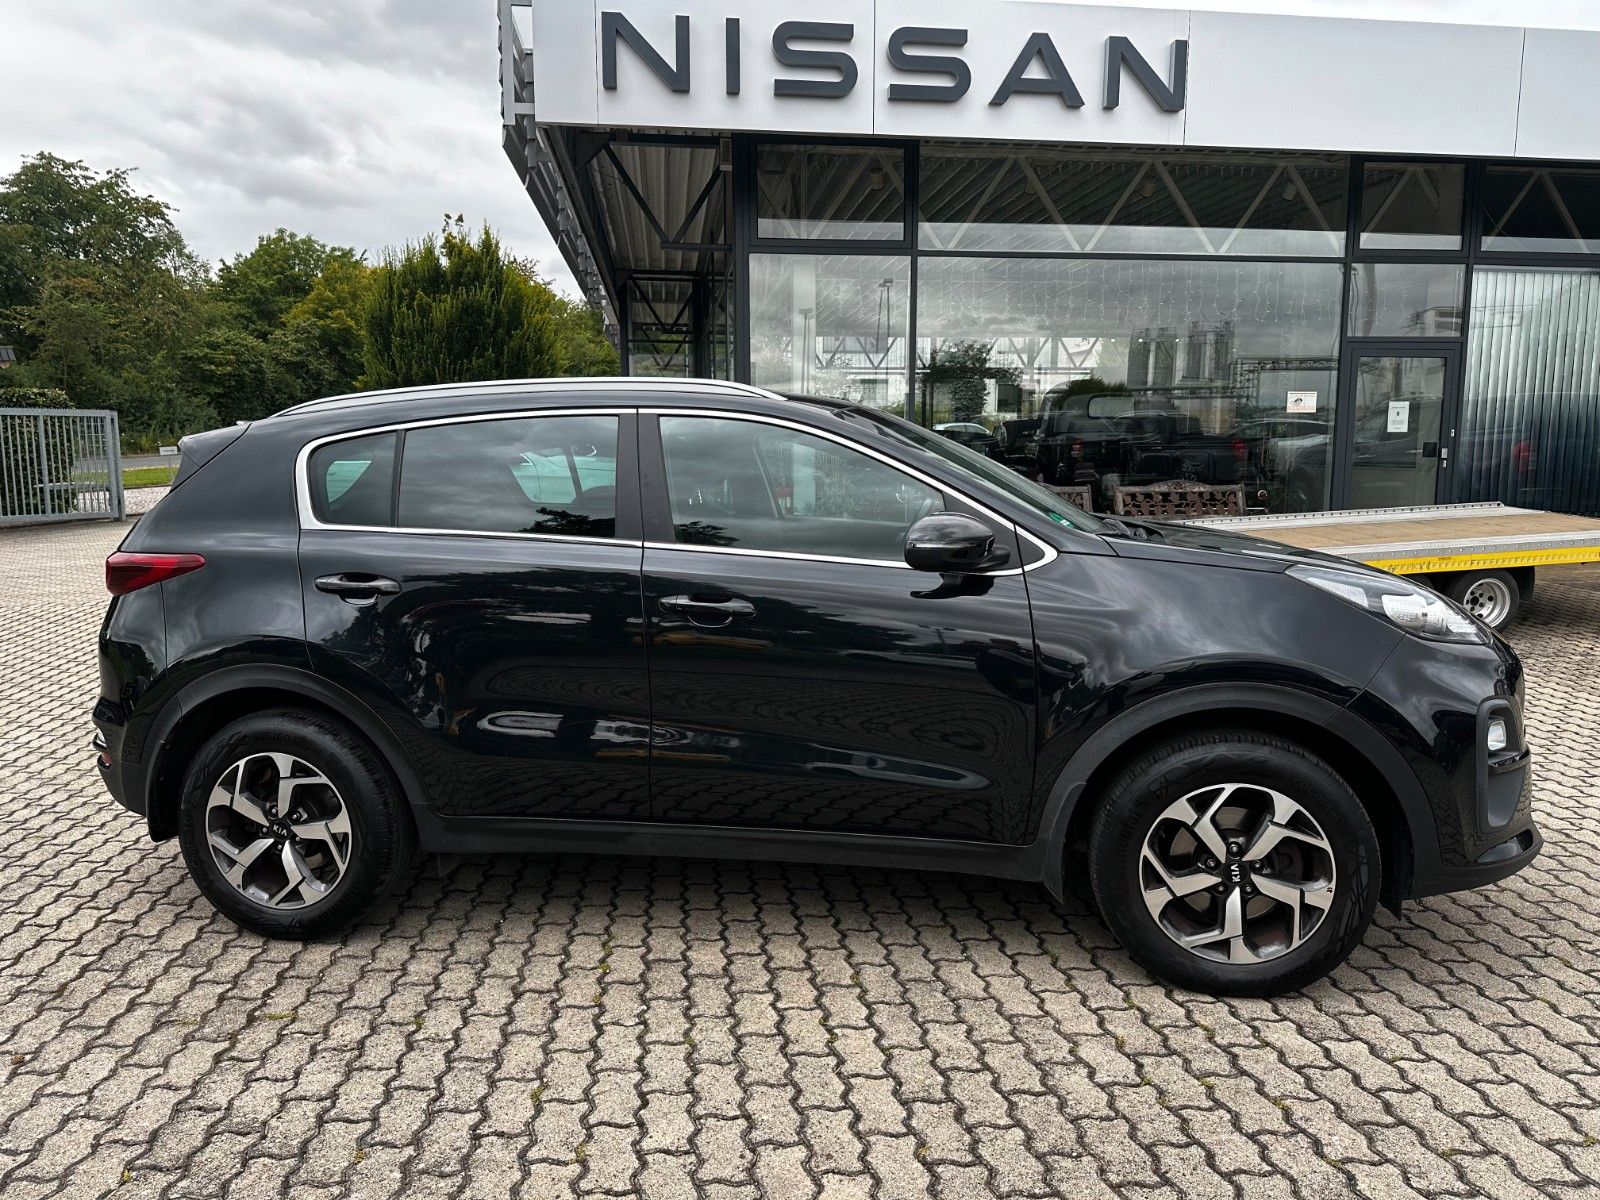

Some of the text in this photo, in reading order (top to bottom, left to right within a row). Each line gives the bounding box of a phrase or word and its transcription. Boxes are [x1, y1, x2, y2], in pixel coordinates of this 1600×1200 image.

[601, 11, 1188, 112] NISSAN
[272, 824, 287, 836] KIA
[1230, 864, 1240, 882] KIA
